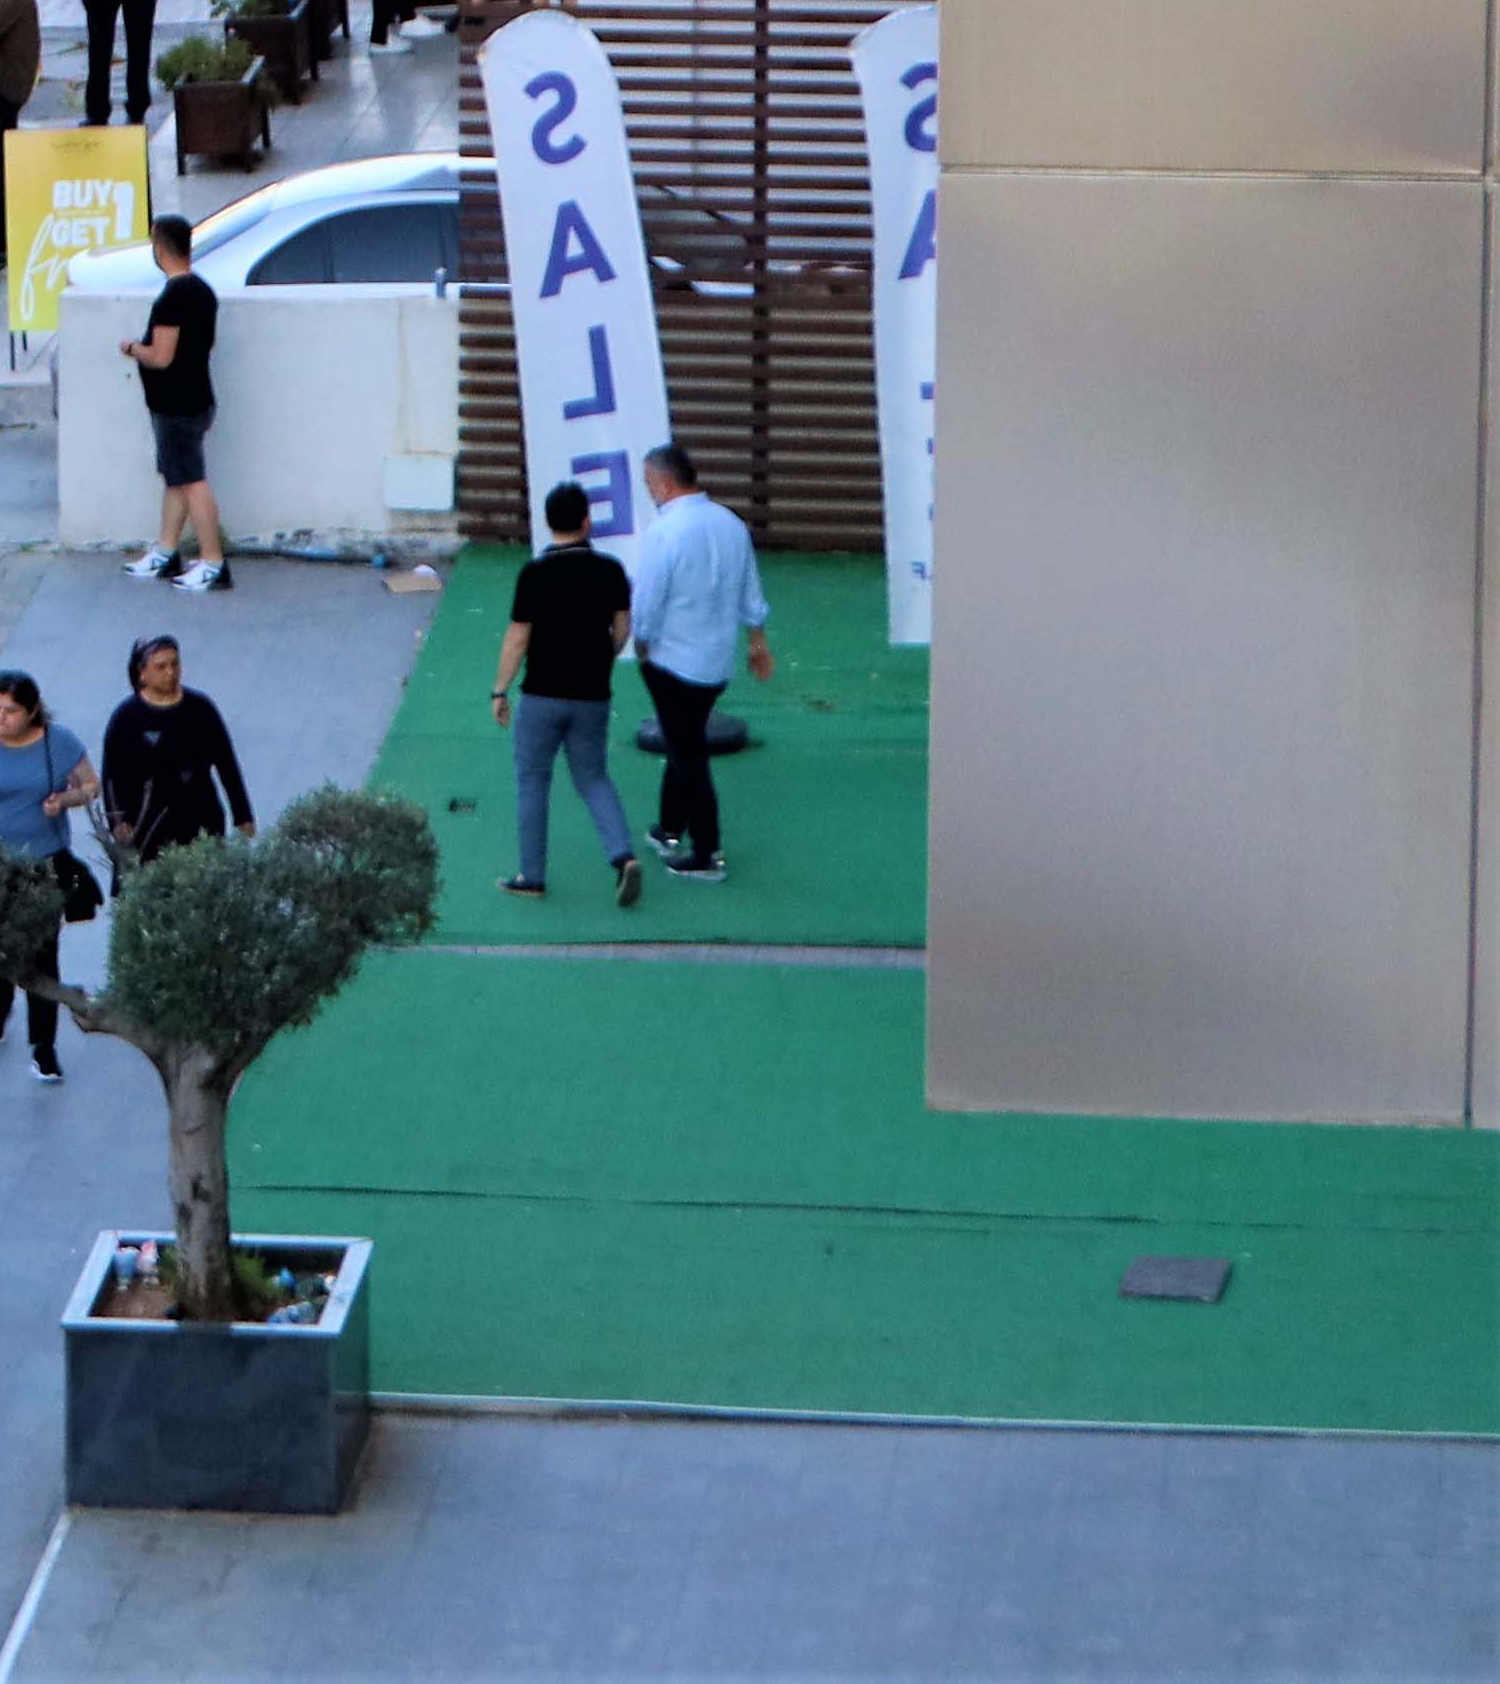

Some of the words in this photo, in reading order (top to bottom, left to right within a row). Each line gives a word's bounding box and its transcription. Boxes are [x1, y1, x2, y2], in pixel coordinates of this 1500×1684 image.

[51, 215, 111, 248] GET
[52, 178, 112, 209] BUY
[114, 181, 135, 241] 1
